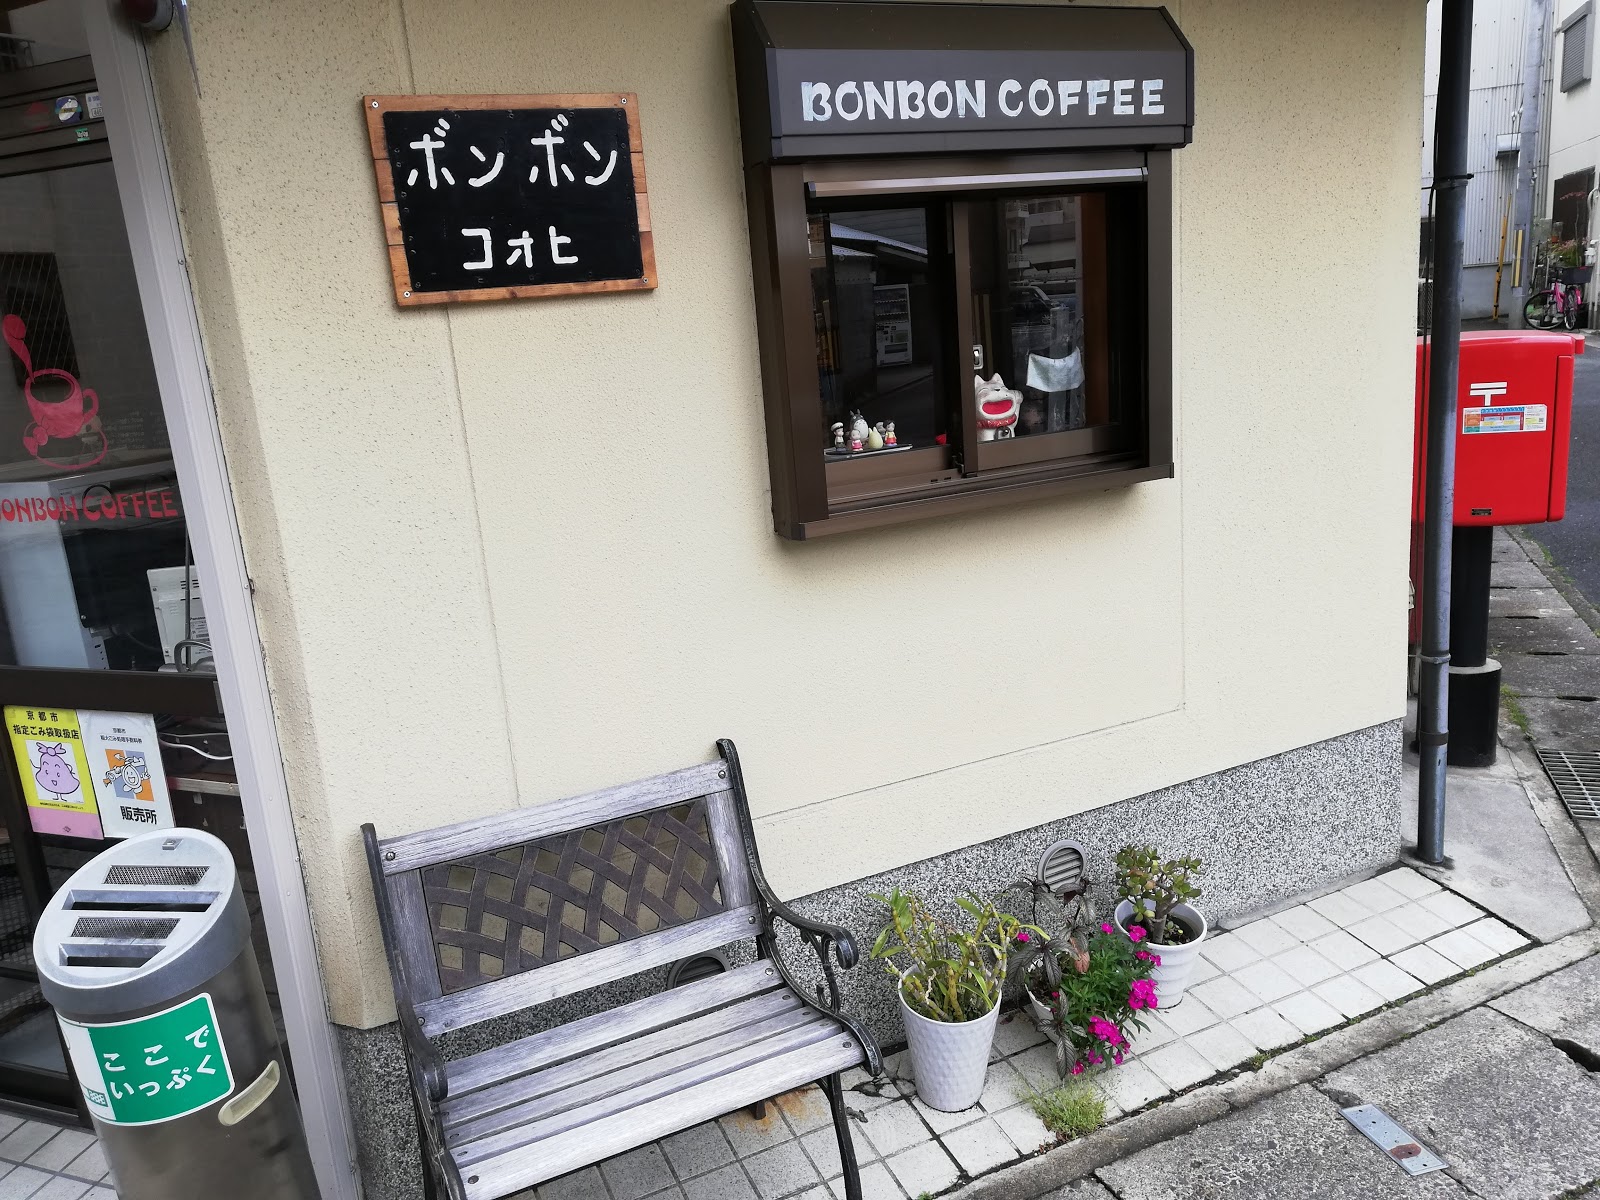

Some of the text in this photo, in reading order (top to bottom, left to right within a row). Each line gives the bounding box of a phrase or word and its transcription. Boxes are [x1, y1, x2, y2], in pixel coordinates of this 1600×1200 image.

[800, 79, 1165, 122] BONBON COFFEE
[407, 114, 617, 189] ボンボン
[461, 225, 578, 269] コオヒ
[0, 491, 179, 523] ONBON COFFEE
[12, 724, 80, 740] 指定ごみ袋取扱店
[26, 710, 59, 722] 京都市
[119, 805, 158, 825] 販売所
[103, 1024, 210, 1072] ここで
[110, 1055, 216, 1099] いっぷく
